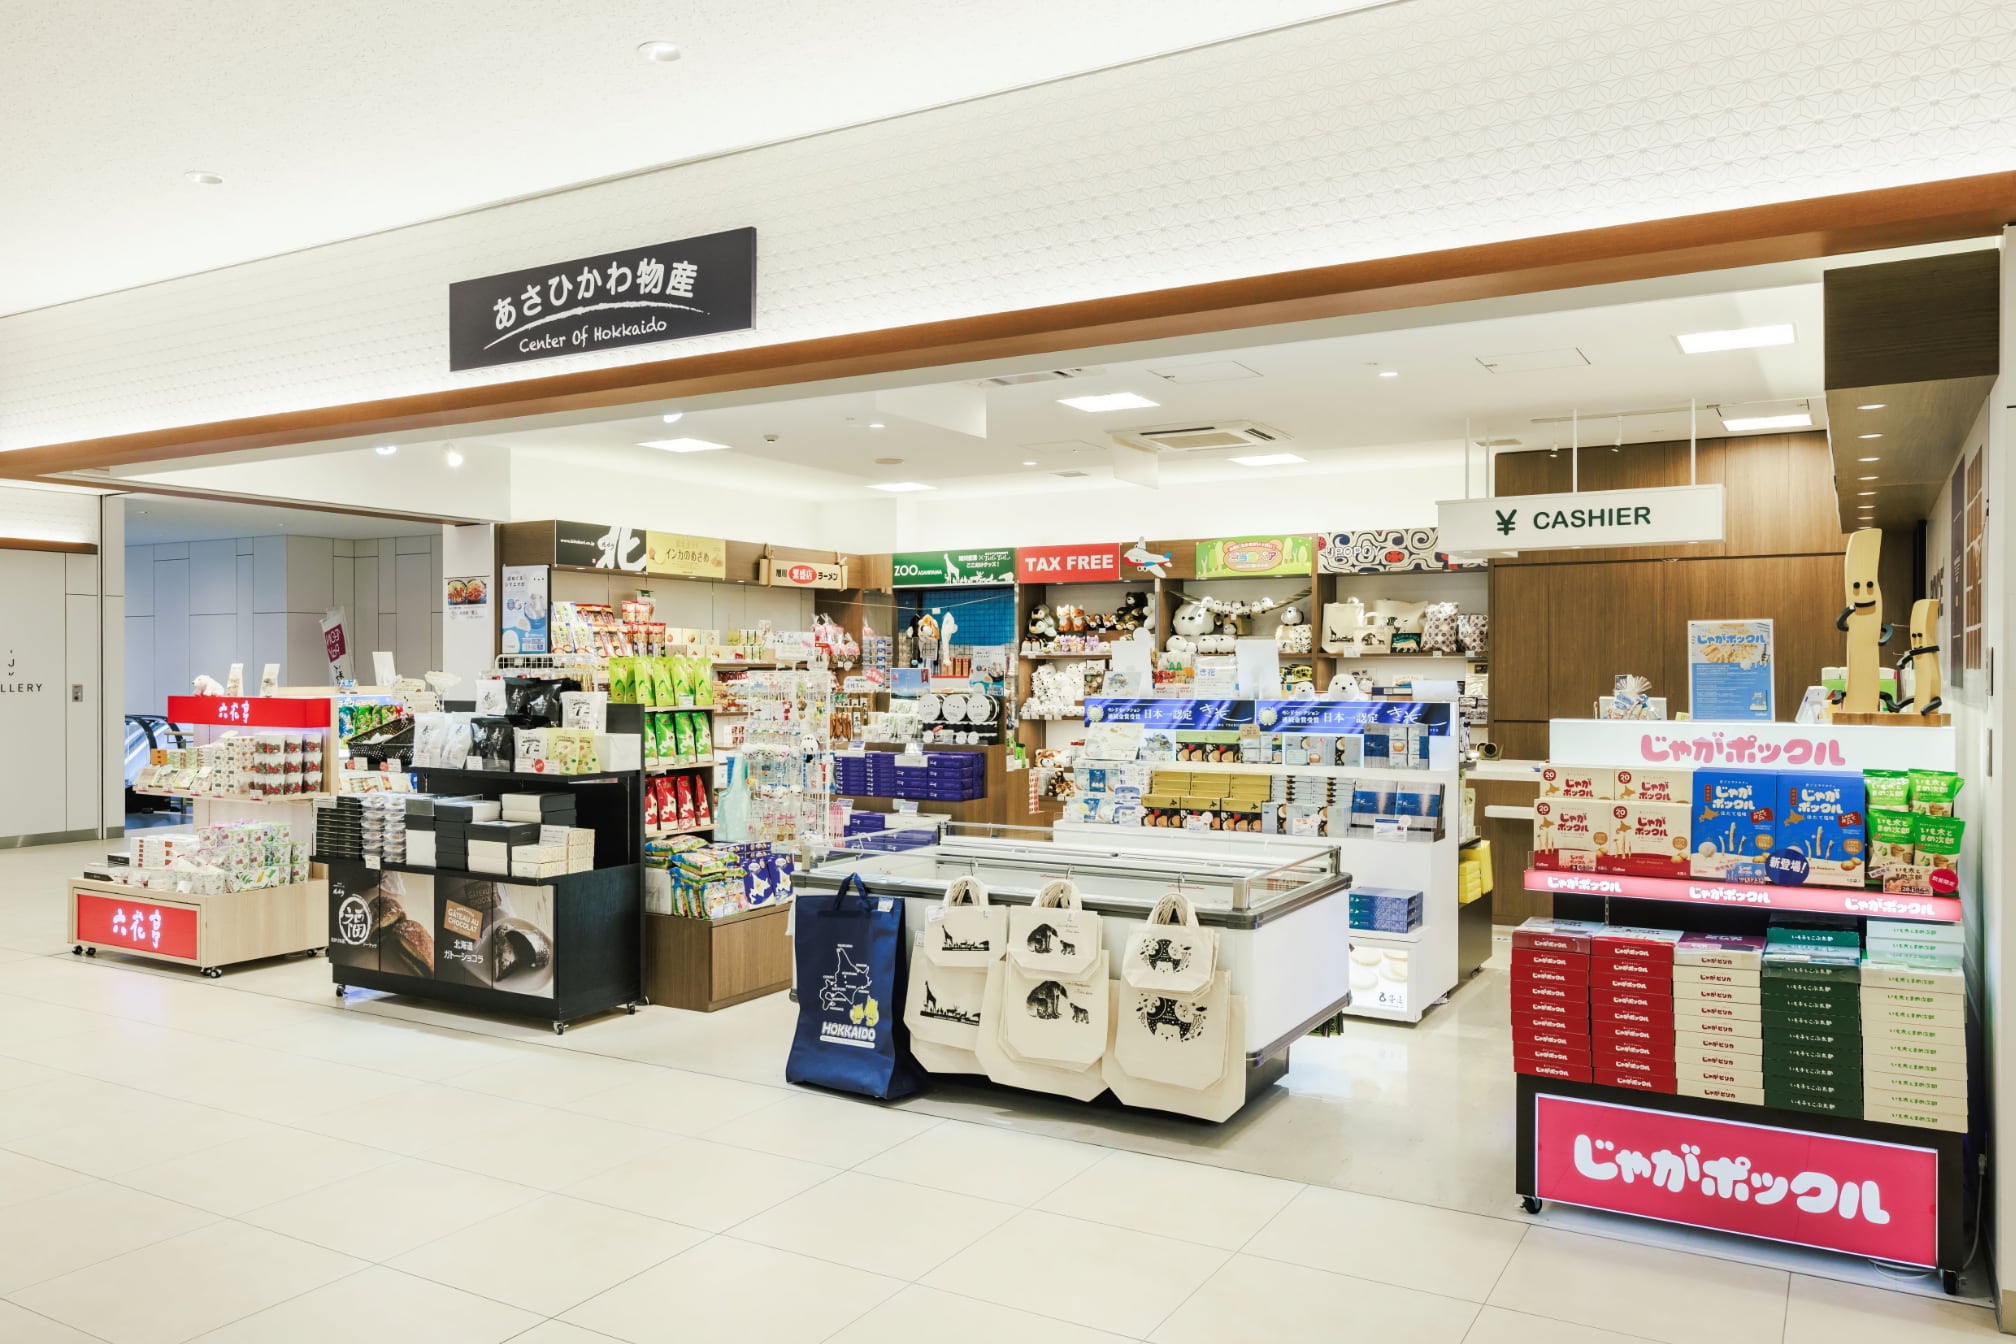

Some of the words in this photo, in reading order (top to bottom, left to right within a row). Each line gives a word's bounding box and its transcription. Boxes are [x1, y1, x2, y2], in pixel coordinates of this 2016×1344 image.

[493, 257, 698, 330] あさひかわ物産
[519, 334, 566, 353] Center
[572, 325, 588, 347] Of
[594, 315, 667, 341] Hokkaido
[1495, 509, 1517, 536] ¥
[1533, 506, 1651, 530] CASHIER
[665, 548, 710, 563] インカのめざめ
[1325, 545, 1381, 558] UPOPOY
[1025, 555, 1064, 573] TAX
[1068, 553, 1114, 571] FREE
[818, 571, 838, 581] ラーメン
[894, 564, 919, 577] ZOO
[1697, 634, 1766, 645] じゃがポックル
[1144, 709, 1193, 721] 日本一認定
[1323, 712, 1378, 723] 日本一認定
[1640, 731, 1846, 766] じゃがポックル
[1565, 778, 1592, 789] じゃが
[1641, 781, 1669, 792] じゃが
[1563, 788, 1594, 797] ポックル
[1638, 792, 1671, 801] ポックル
[1715, 785, 1753, 799] じゃが
[1801, 788, 1840, 803] じゃが
[1712, 798, 1756, 810] ポックル
[1798, 801, 1844, 814] ポックル
[1560, 812, 1587, 823] じゃが
[1637, 816, 1666, 827] じゃが
[1557, 823, 1589, 832] ポックル
[1635, 827, 1668, 837] ポックル
[1769, 856, 1807, 874] 新登場!
[1547, 876, 1622, 894] じゃがポックル
[1689, 885, 1771, 905] じゃがポックル
[1844, 897, 1936, 917] じゃがポックル
[112, 908, 163, 949] 六花亭
[453, 939, 473, 951] 北海道
[444, 949, 484, 964] ガトーショコラ
[1615, 948, 1649, 956] じゃがポックル
[1614, 964, 1648, 972] じゃがポックル
[1612, 980, 1646, 988] じゃがポックル
[1614, 997, 1648, 1005] じゃがポックル
[1615, 1013, 1648, 1022] じゃがポックル
[821, 1021, 876, 1042] HOKKAIDO
[1615, 1030, 1649, 1038] じゃがポックル
[1616, 1046, 1649, 1054] じゃがポックル
[1616, 1061, 1650, 1070] じゃがポックル
[1617, 1078, 1651, 1087] じゃがポックル
[1573, 1133, 1891, 1225] じゃがポックル
